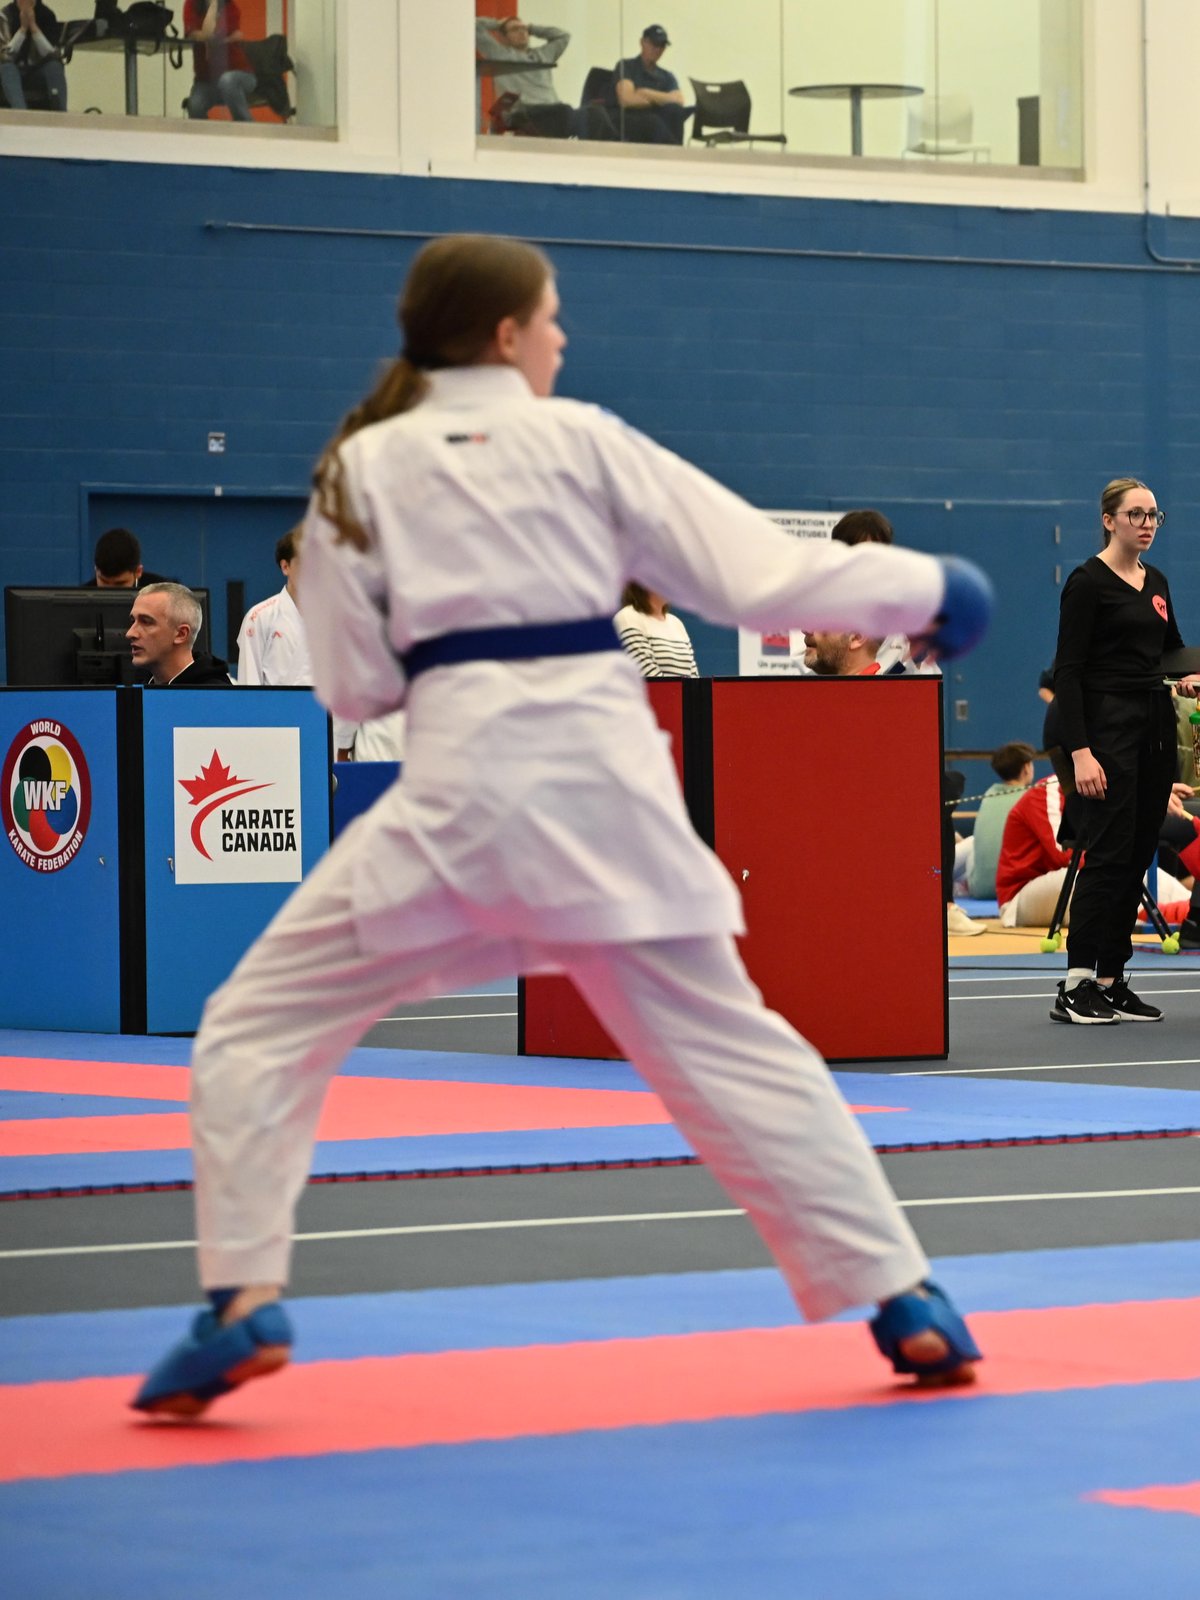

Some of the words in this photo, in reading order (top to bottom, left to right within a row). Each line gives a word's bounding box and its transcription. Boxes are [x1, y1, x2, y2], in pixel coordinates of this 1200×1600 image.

[30, 721, 62, 737] WORLD
[23, 780, 67, 811] WKF
[221, 809, 295, 830] KARATE
[8, 828, 36, 868] KARATE
[37, 829, 84, 872] FEDERATION
[222, 832, 297, 853] CANADA
